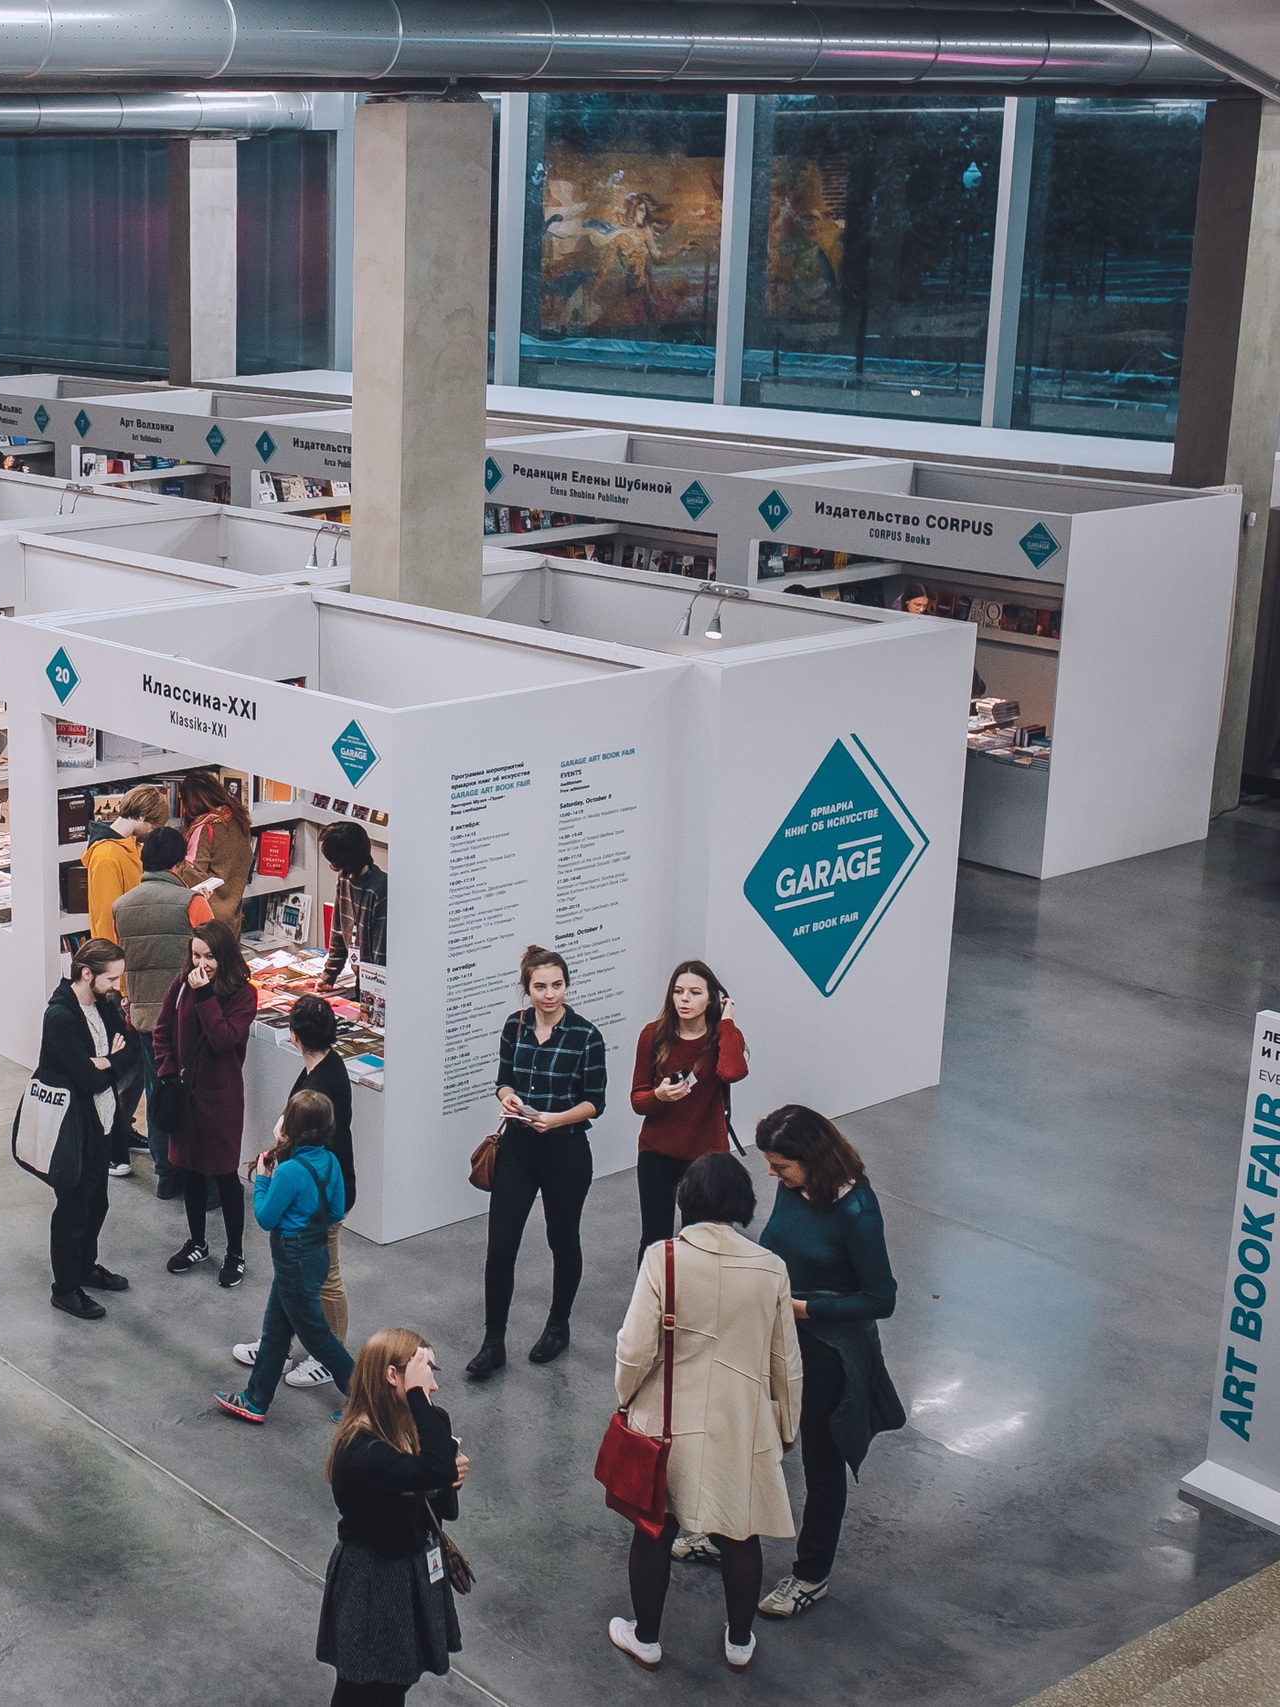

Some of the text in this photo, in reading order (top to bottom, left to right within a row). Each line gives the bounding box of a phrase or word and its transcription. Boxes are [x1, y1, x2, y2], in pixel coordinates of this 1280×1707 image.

[120, 416, 174, 432] Арт Волхонка
[263, 442, 268, 451] 8
[324, 457, 336, 467] Arca
[486, 469, 493, 480] 9
[512, 463, 673, 494] Редакция Елены Шубиной
[550, 486, 630, 505] Elena Shubina Publisher
[767, 503, 781, 516] 10
[814, 500, 994, 537] Издательство CORPUS
[869, 527, 931, 546] CORPUS Books
[55, 665, 70, 685] 20
[142, 673, 257, 721] Классика-XXI
[169, 709, 227, 739] Klassika-XXI
[340, 747, 368, 761] GARAGE
[560, 748, 636, 768] GARAGE ART BOOK FAIR
[451, 761, 525, 781] Программа мероприятий
[451, 770, 531, 791] ярмарки книг об искусстве
[560, 769, 582, 779] EVENTS
[450, 779, 531, 800] GARAGE ART BOOK FAIR
[559, 800, 584, 810] Saturday,
[585, 794, 607, 804] October
[810, 800, 854, 819] ЯРМАРКА
[784, 808, 879, 838] КНИГ ОБ ИСКУССТВЕ
[775, 846, 882, 899] GARAGE
[554, 932, 575, 941] Sunday,
[576, 926, 598, 936] October
[792, 911, 859, 938] ART BOOK FAIR
[1220, 1092, 1280, 1443] ART BOOK FAIR
